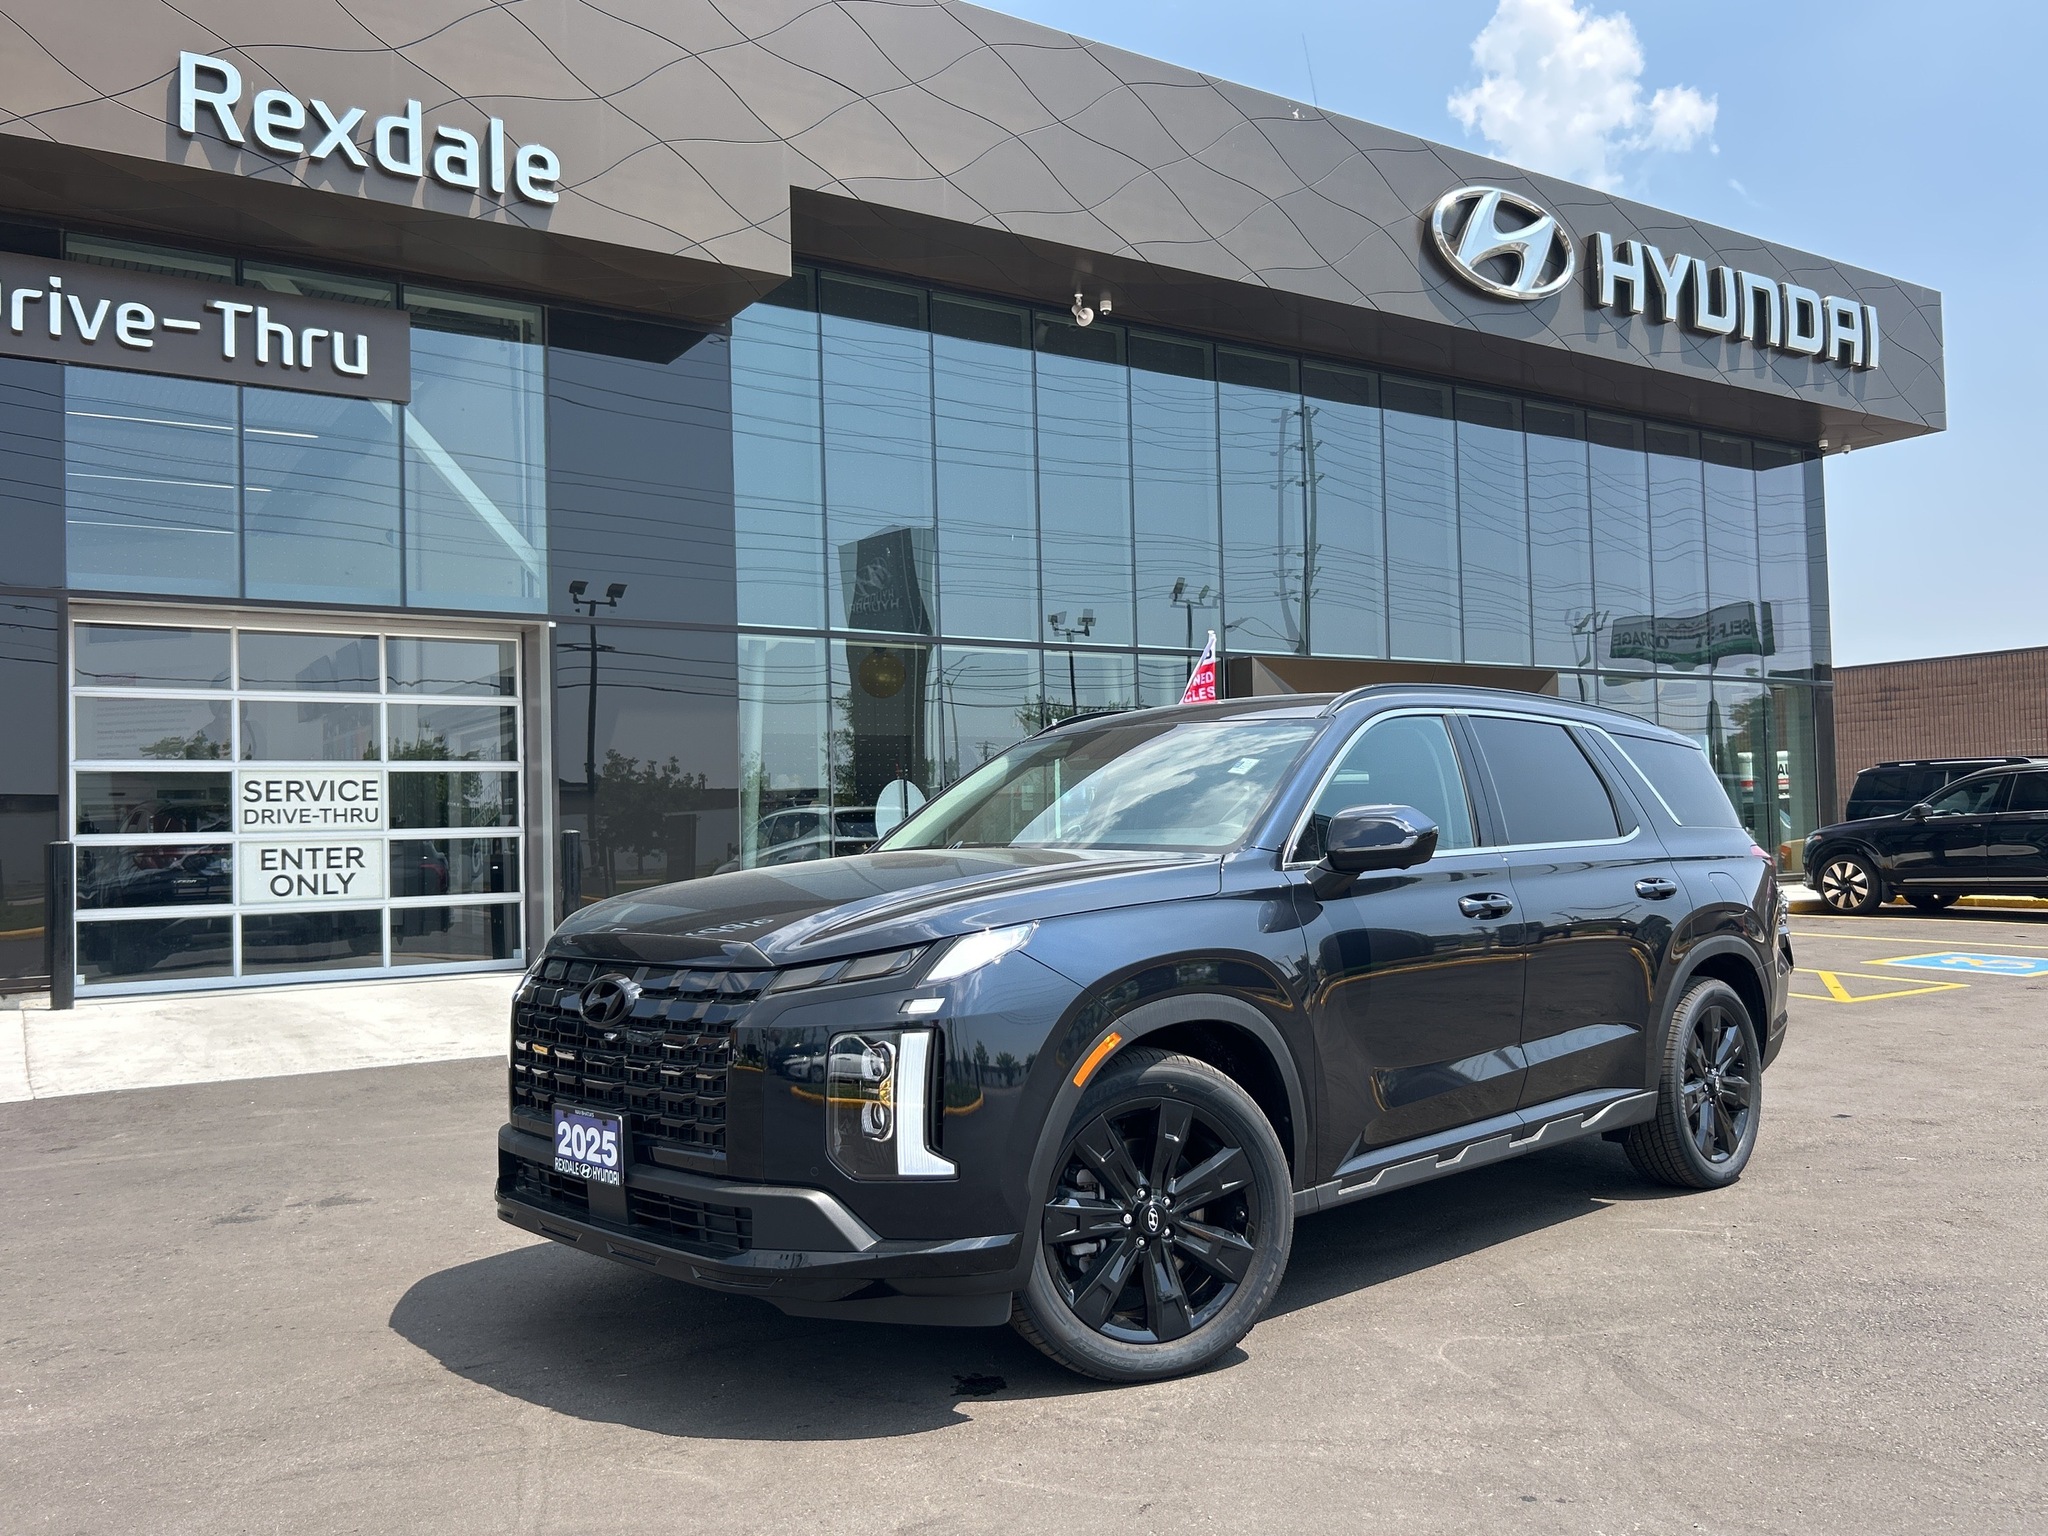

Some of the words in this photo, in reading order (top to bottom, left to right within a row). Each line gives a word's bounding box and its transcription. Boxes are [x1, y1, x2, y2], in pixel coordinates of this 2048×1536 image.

[179, 50, 561, 205] Rexdale
[1594, 231, 1879, 370] HYUNDAI
[0, 275, 369, 377] rive-Thru
[243, 779, 378, 803] SERVICE
[244, 807, 379, 825] DRIVE-THRU
[261, 846, 366, 871] ENTER
[270, 872, 356, 897] ONLY
[557, 1120, 618, 1167] 2025
[554, 1157, 580, 1176] REXDALE
[592, 1165, 620, 1186] HYUNDAI
